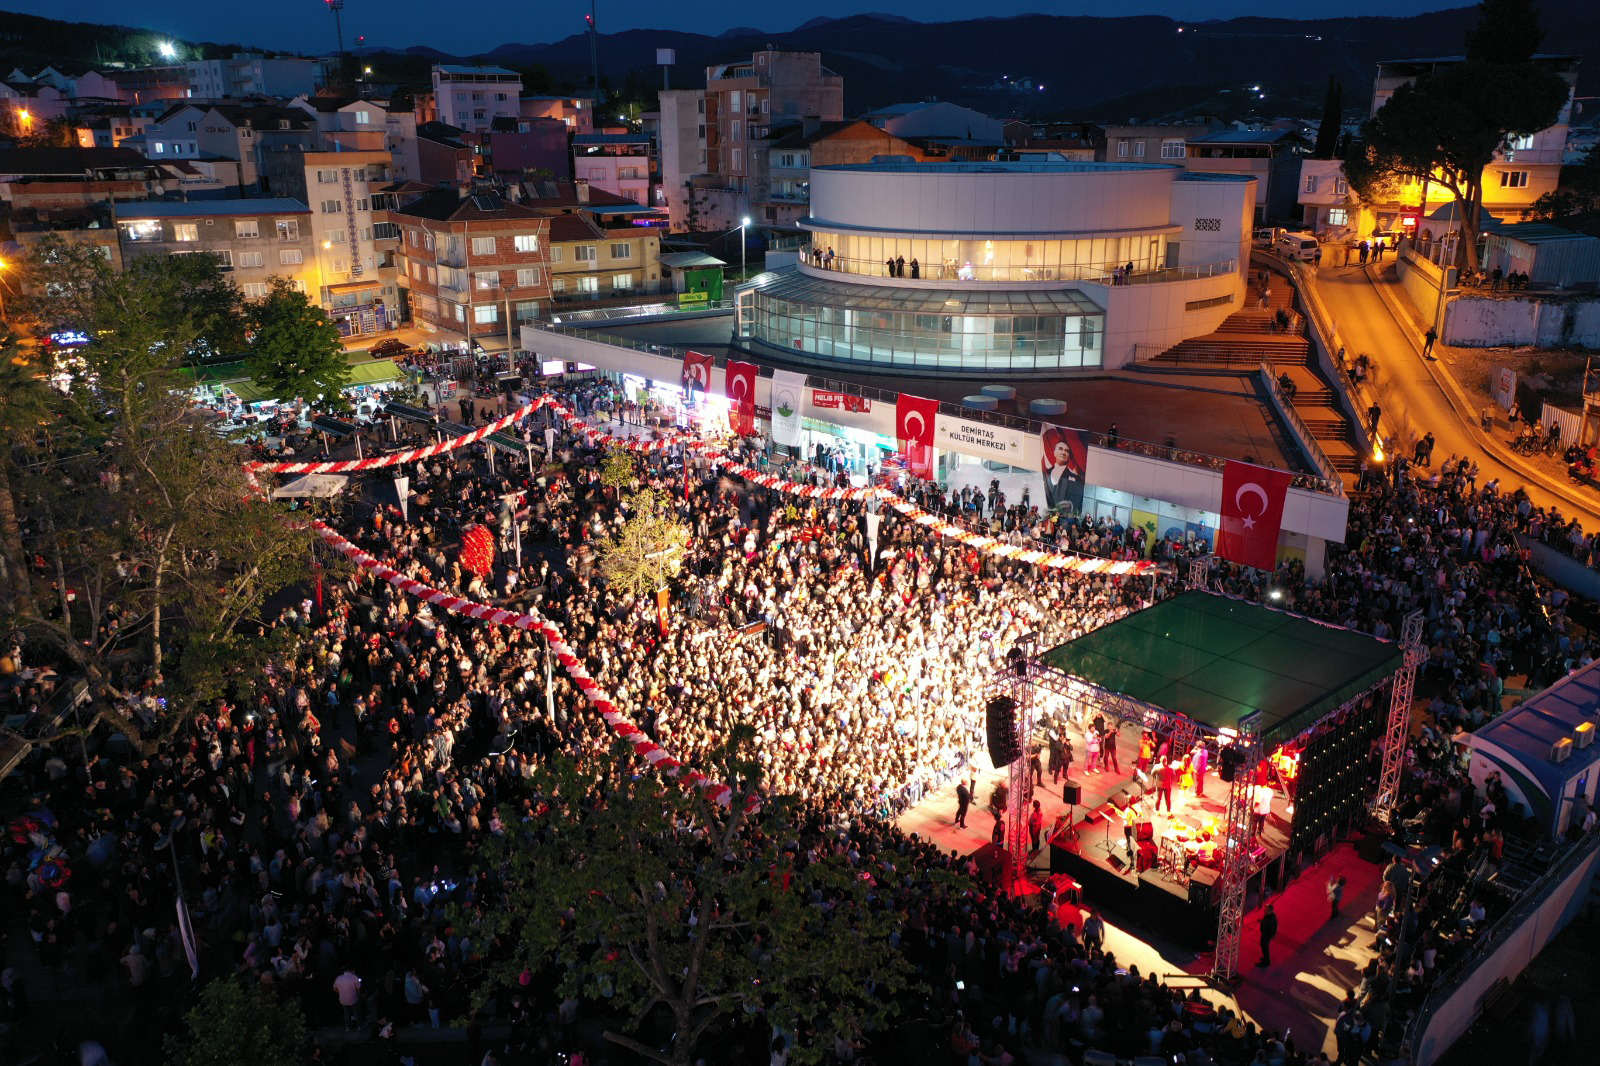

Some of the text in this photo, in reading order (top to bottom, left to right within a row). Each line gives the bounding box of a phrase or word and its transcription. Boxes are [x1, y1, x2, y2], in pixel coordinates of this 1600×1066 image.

[949, 431, 1006, 451] KÜLTÜR MERKEZİ
[961, 425, 995, 440] DEMİRTAŞ
